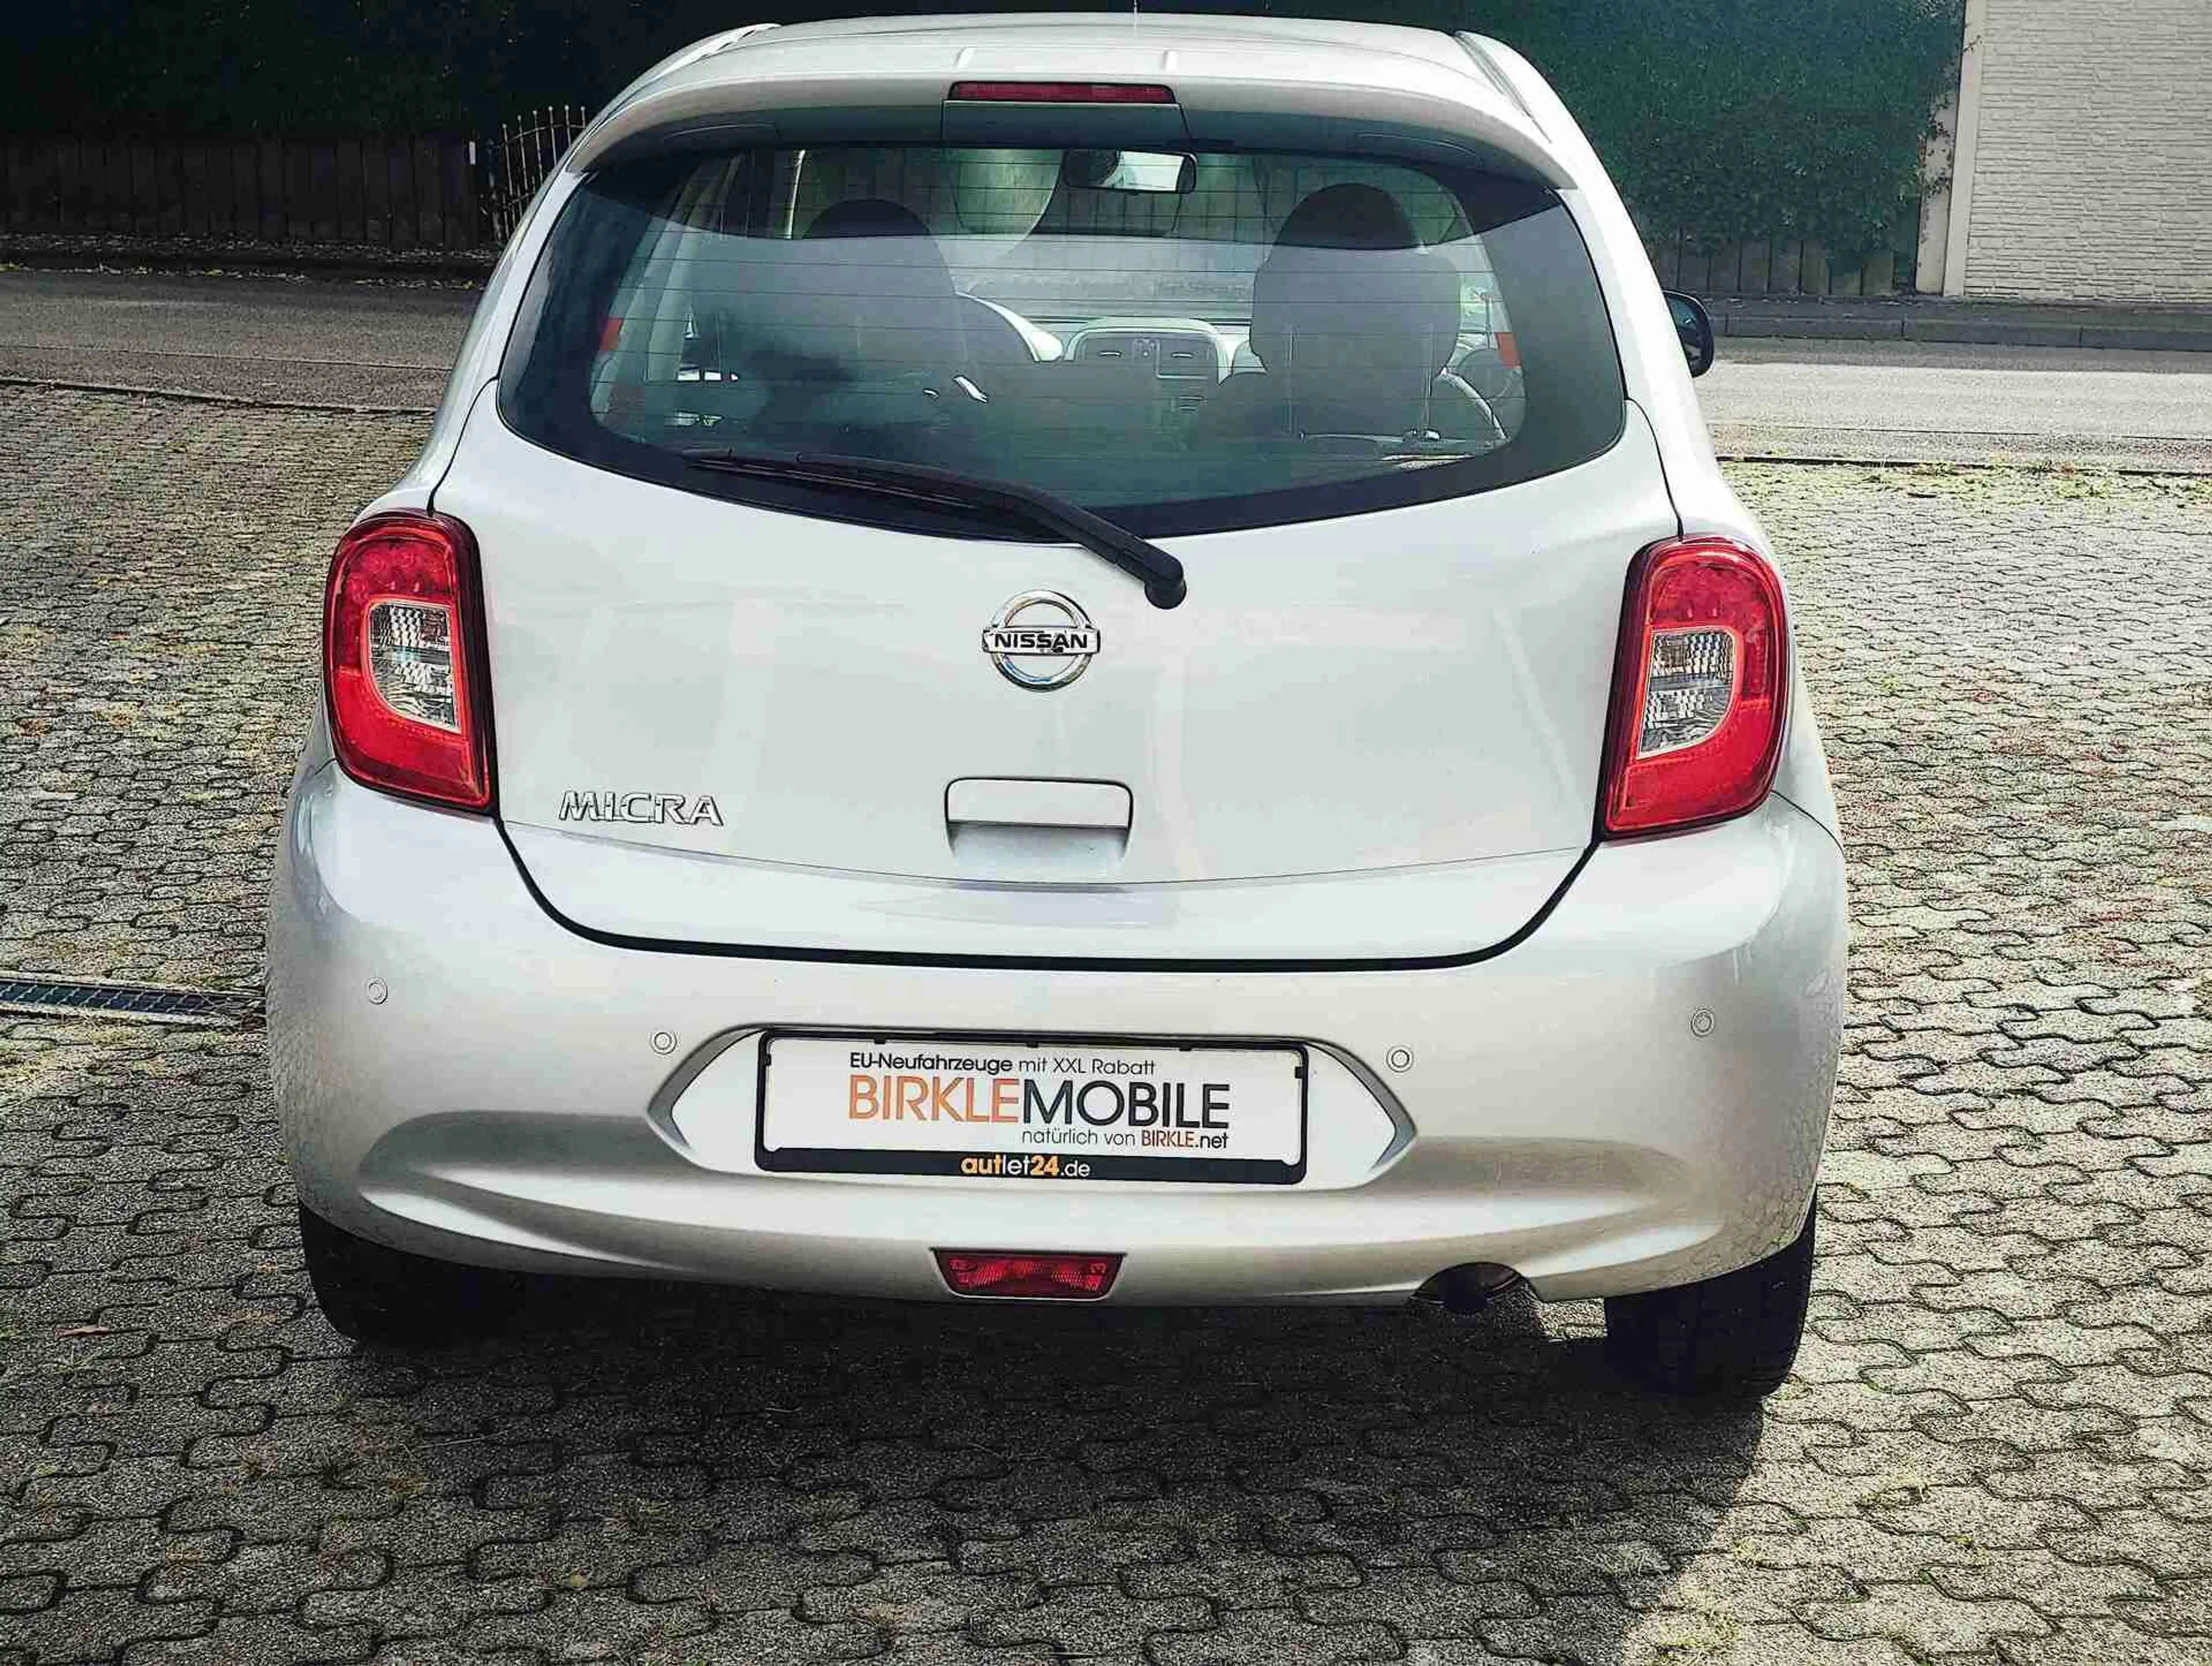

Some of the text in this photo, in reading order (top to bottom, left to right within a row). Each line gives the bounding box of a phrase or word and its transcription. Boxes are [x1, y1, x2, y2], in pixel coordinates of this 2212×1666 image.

[994, 633, 1087, 648] NISSAN
[559, 790, 724, 827] MICRA
[850, 1052, 1157, 1075] EU-Neufahrzeuge mit XXL Rabatt
[849, 1074, 1230, 1129] BIRKLEMOBILE
[1022, 1129, 1229, 1149] natürlich von BIRKLE.net
[960, 1153, 1091, 1178] autlet24.de
